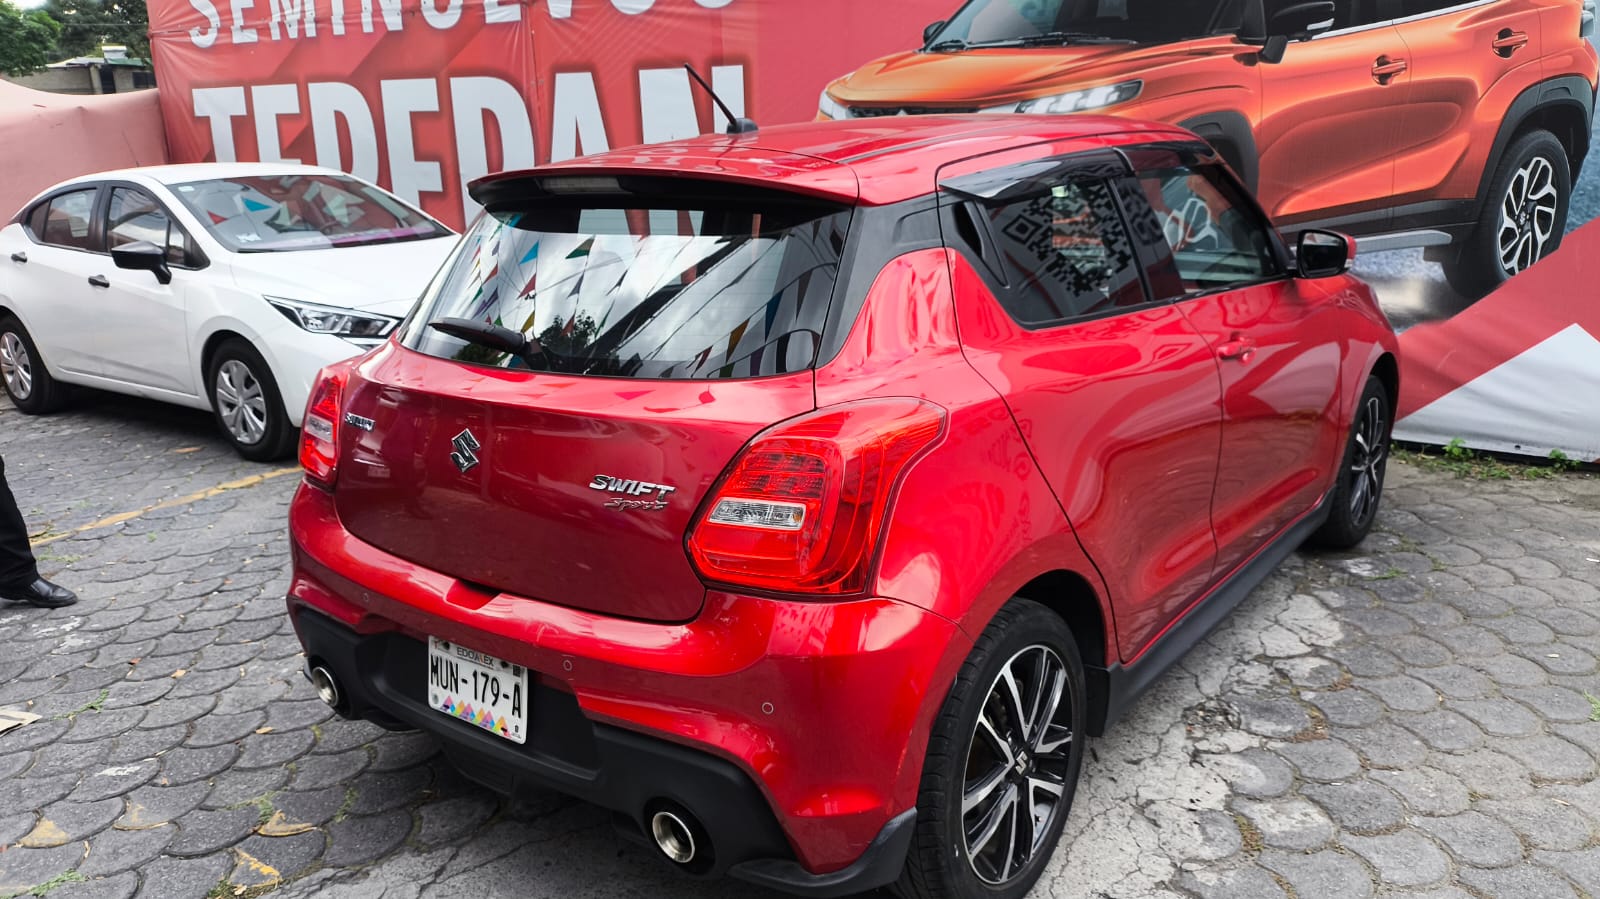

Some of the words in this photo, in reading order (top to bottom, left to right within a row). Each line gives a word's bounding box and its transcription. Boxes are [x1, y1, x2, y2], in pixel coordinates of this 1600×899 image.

[589, 474, 676, 500] SWIFT
[603, 497, 669, 512] Sport
[430, 653, 522, 719] MUN-179-A
